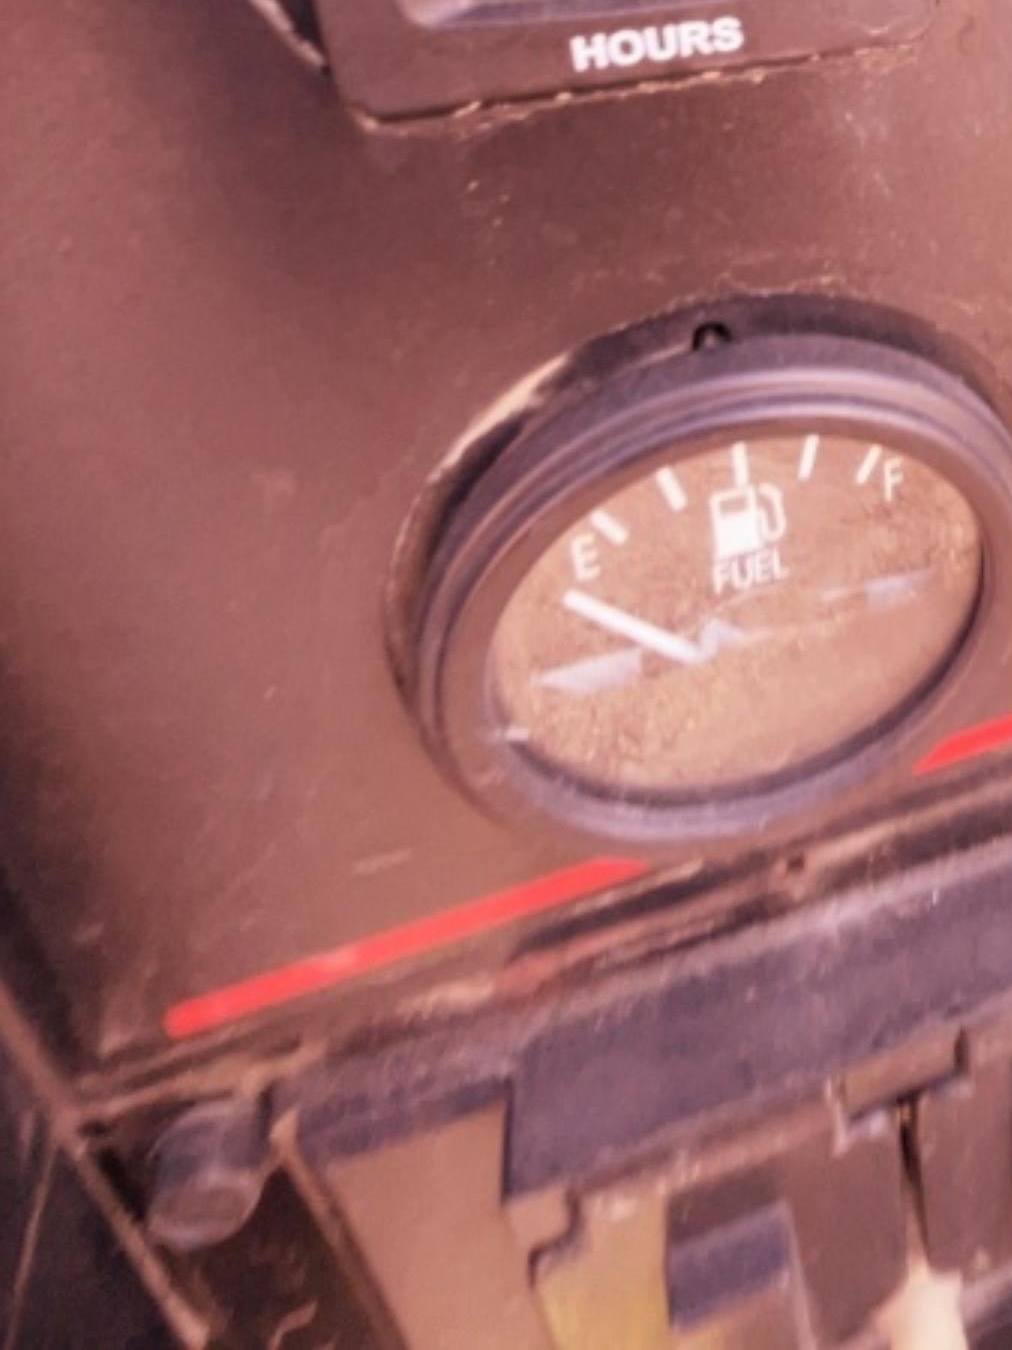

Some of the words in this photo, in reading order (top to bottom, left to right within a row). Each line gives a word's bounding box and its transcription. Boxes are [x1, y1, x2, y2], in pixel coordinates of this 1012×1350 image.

[569, 16, 745, 73] HOURS
[882, 457, 905, 503] F
[569, 533, 603, 584] E
[711, 555, 789, 596] FUEL
